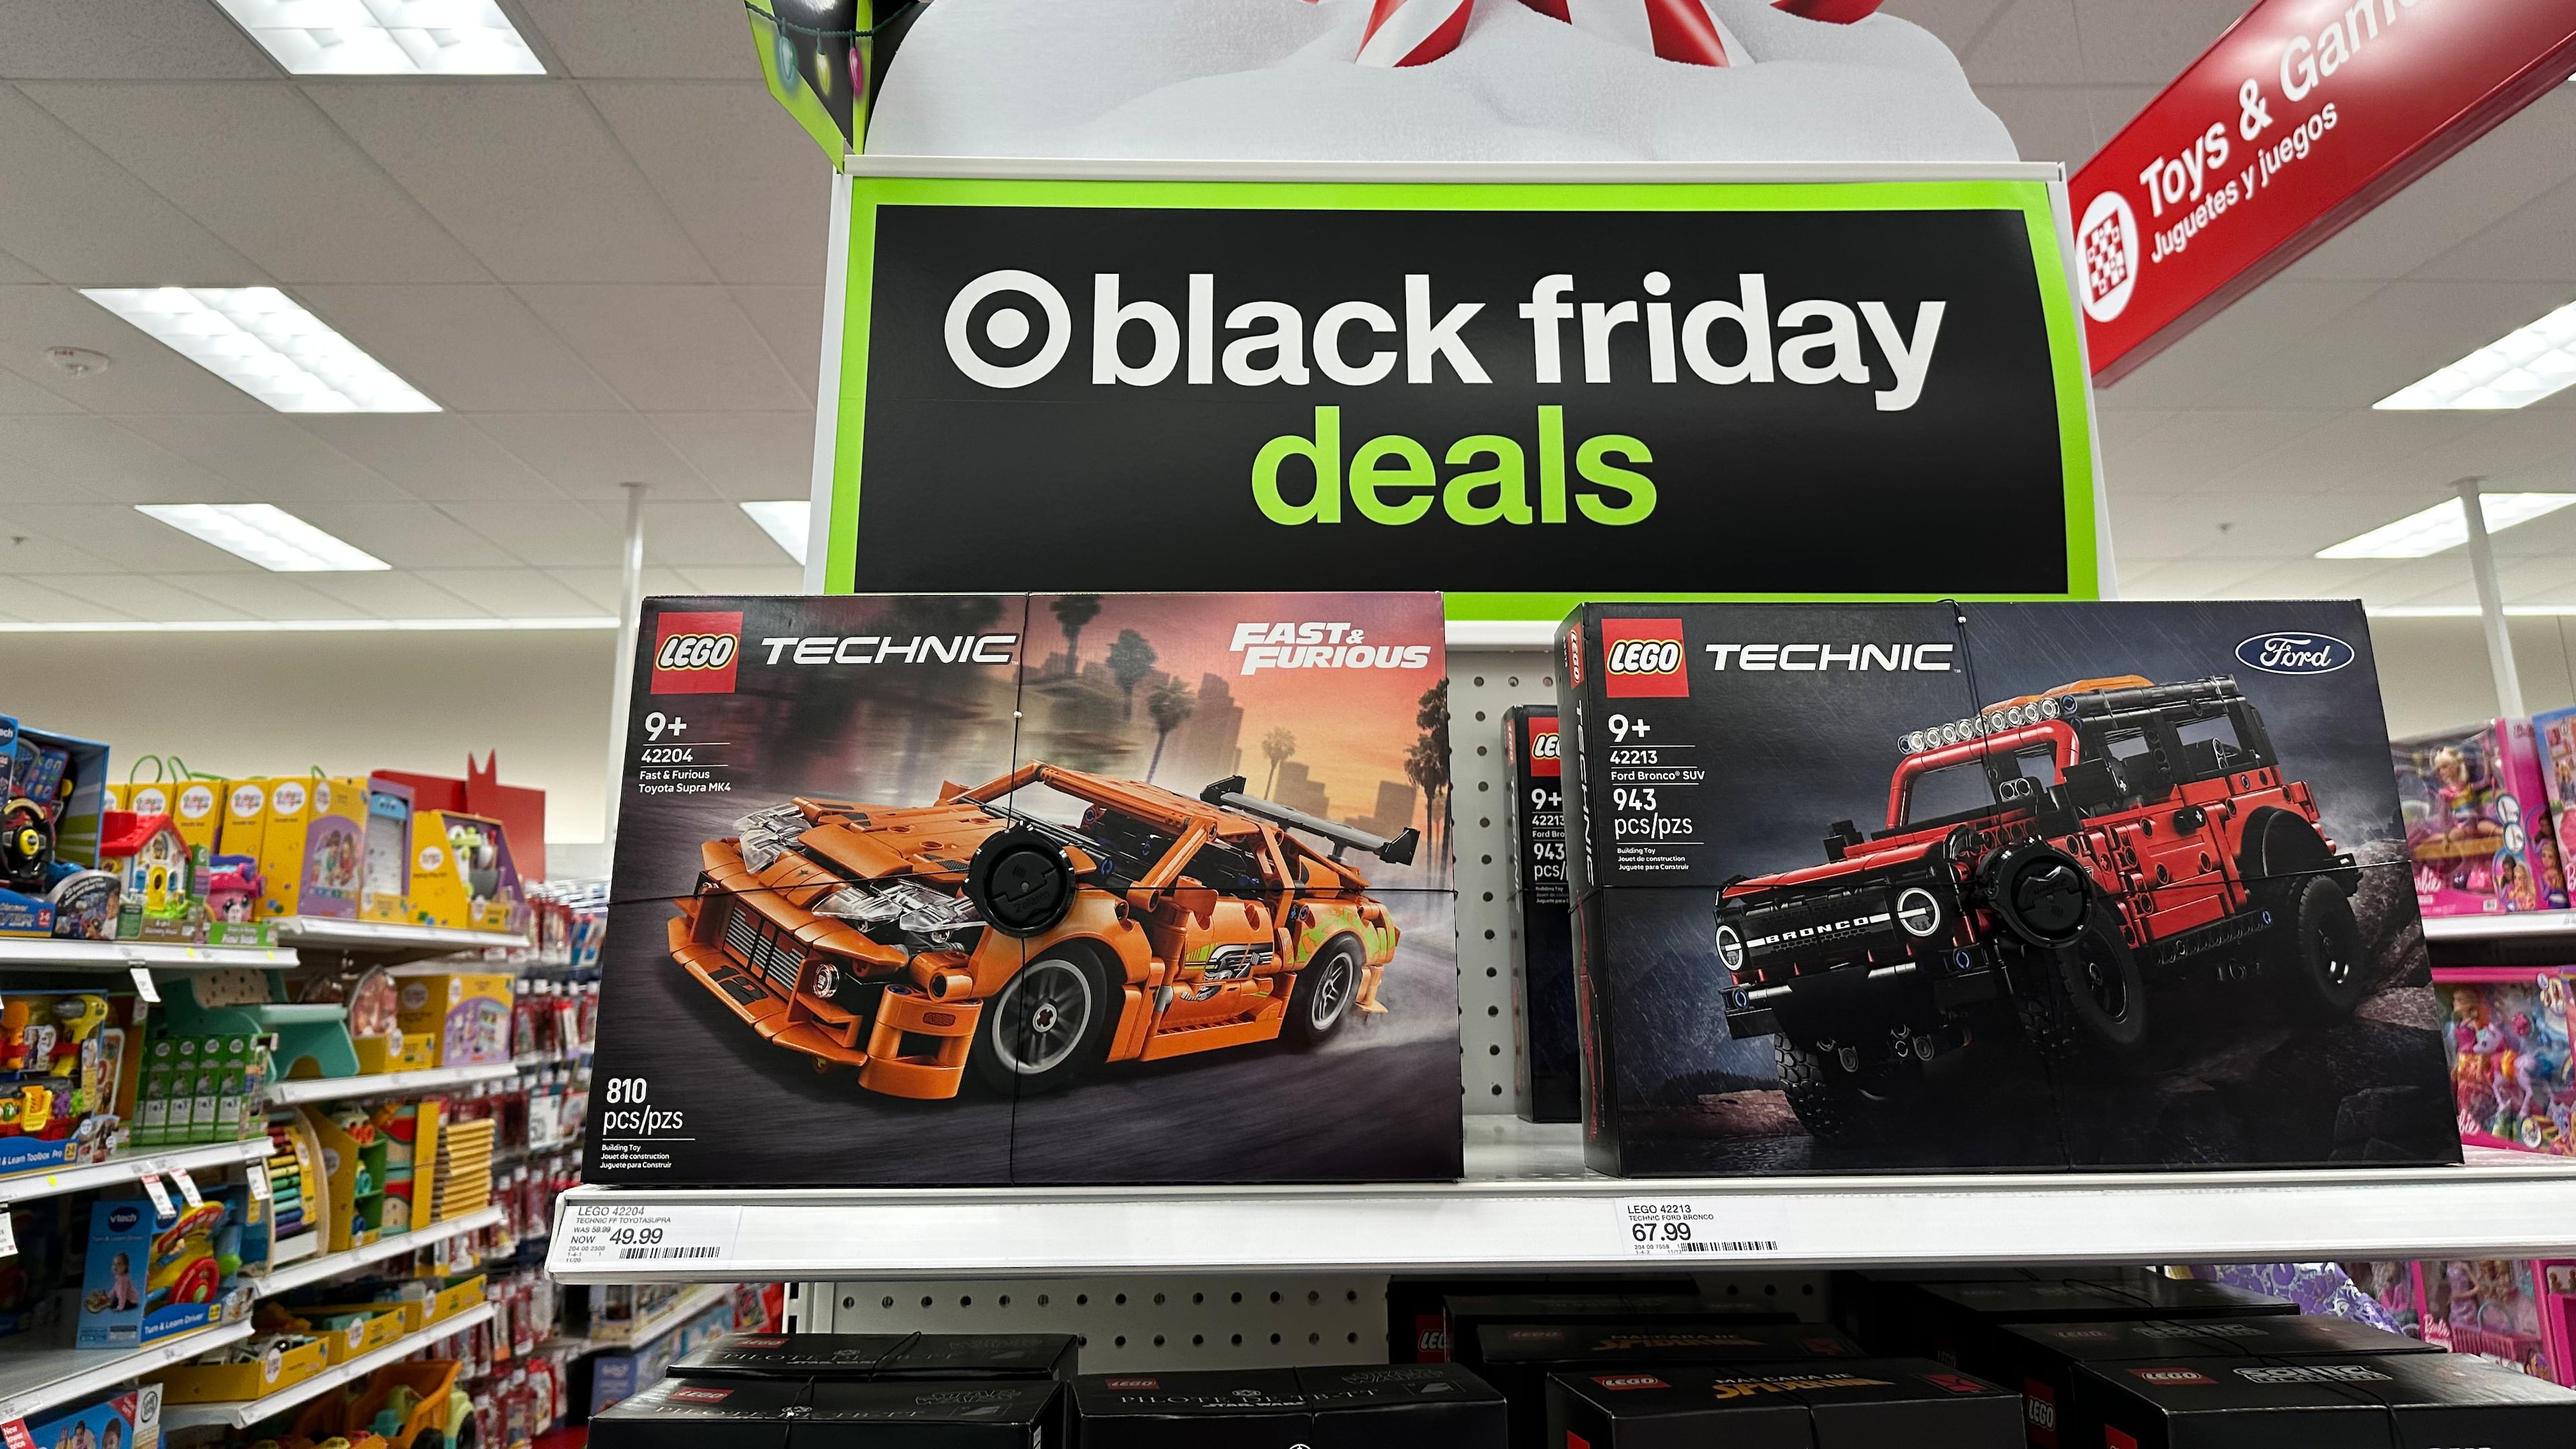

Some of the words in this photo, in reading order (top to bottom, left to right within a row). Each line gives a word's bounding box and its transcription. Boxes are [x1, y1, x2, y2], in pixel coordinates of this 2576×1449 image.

[2139, 121, 2229, 217] Toys
[2239, 78, 2273, 140] &
[2279, 0, 2418, 102] Gam
[2151, 178, 2239, 262] Juguetes
[2239, 164, 2256, 199] y
[2259, 102, 2338, 186] juegos
[1093, 272, 1491, 386] black
[1519, 270, 1945, 411] friday
[1251, 405, 1657, 527] deals
[1229, 623, 1350, 651] FAST
[1345, 629, 1365, 644] &
[657, 635, 737, 669] LEGO
[761, 635, 1019, 665] TECHNIC
[1240, 645, 1431, 676] FURIOUS
[1570, 629, 1580, 683] LEGO
[1609, 640, 1682, 675] LEGO
[1705, 643, 1953, 671] TECHNIC
[2259, 637, 2332, 667] Ford
[644, 711, 687, 741] 9+
[1608, 714, 1650, 743] 9+
[641, 748, 693, 763] 42204
[1533, 733, 1560, 759] LE
[1610, 750, 1658, 764] 42213
[639, 769, 661, 780] Fast
[663, 769, 670, 780] &
[672, 769, 710, 780] Furious
[1611, 771, 1635, 780] Ford
[1682, 771, 1705, 780] SUV
[639, 784, 674, 794] Toyota
[676, 783, 706, 794] Supra
[708, 782, 731, 792] MK4
[1531, 788, 1562, 810] 9+
[1576, 699, 1594, 887] TECHNIC
[1613, 788, 1657, 810] 943
[1615, 812, 1693, 840] pcs/pzs
[1533, 843, 1565, 860] 943
[1617, 847, 1643, 855] Building
[1534, 861, 1568, 881] pcs/
[1765, 916, 1869, 943] BRONCO
[606, 1078, 647, 1104] 810
[603, 1105, 684, 1135] pcs/pzs
[7, 1155, 25, 1165] Learn
[27, 1152, 50, 1162] Toolbox
[52, 1149, 62, 1159] Pro
[578, 1207, 609, 1216] LEGO
[612, 1207, 645, 1216] 42204
[1627, 1205, 1657, 1214] LEGO
[1660, 1205, 1691, 1214] 42213
[571, 1236, 596, 1244] NOW
[609, 1228, 663, 1244] 49.99
[1632, 1222, 1691, 1242] 67.99
[144, 1325, 159, 1334] Turn
[165, 1318, 184, 1329] Learn
[184, 1313, 204, 1324] Driver
[1601, 1377, 1658, 1387] LEGO
[2142, 1371, 2201, 1381] LEGO
[2028, 1396, 2055, 1431] LEGO
[3, 1426, 18, 1434] New
[6, 1432, 23, 1442] lower
